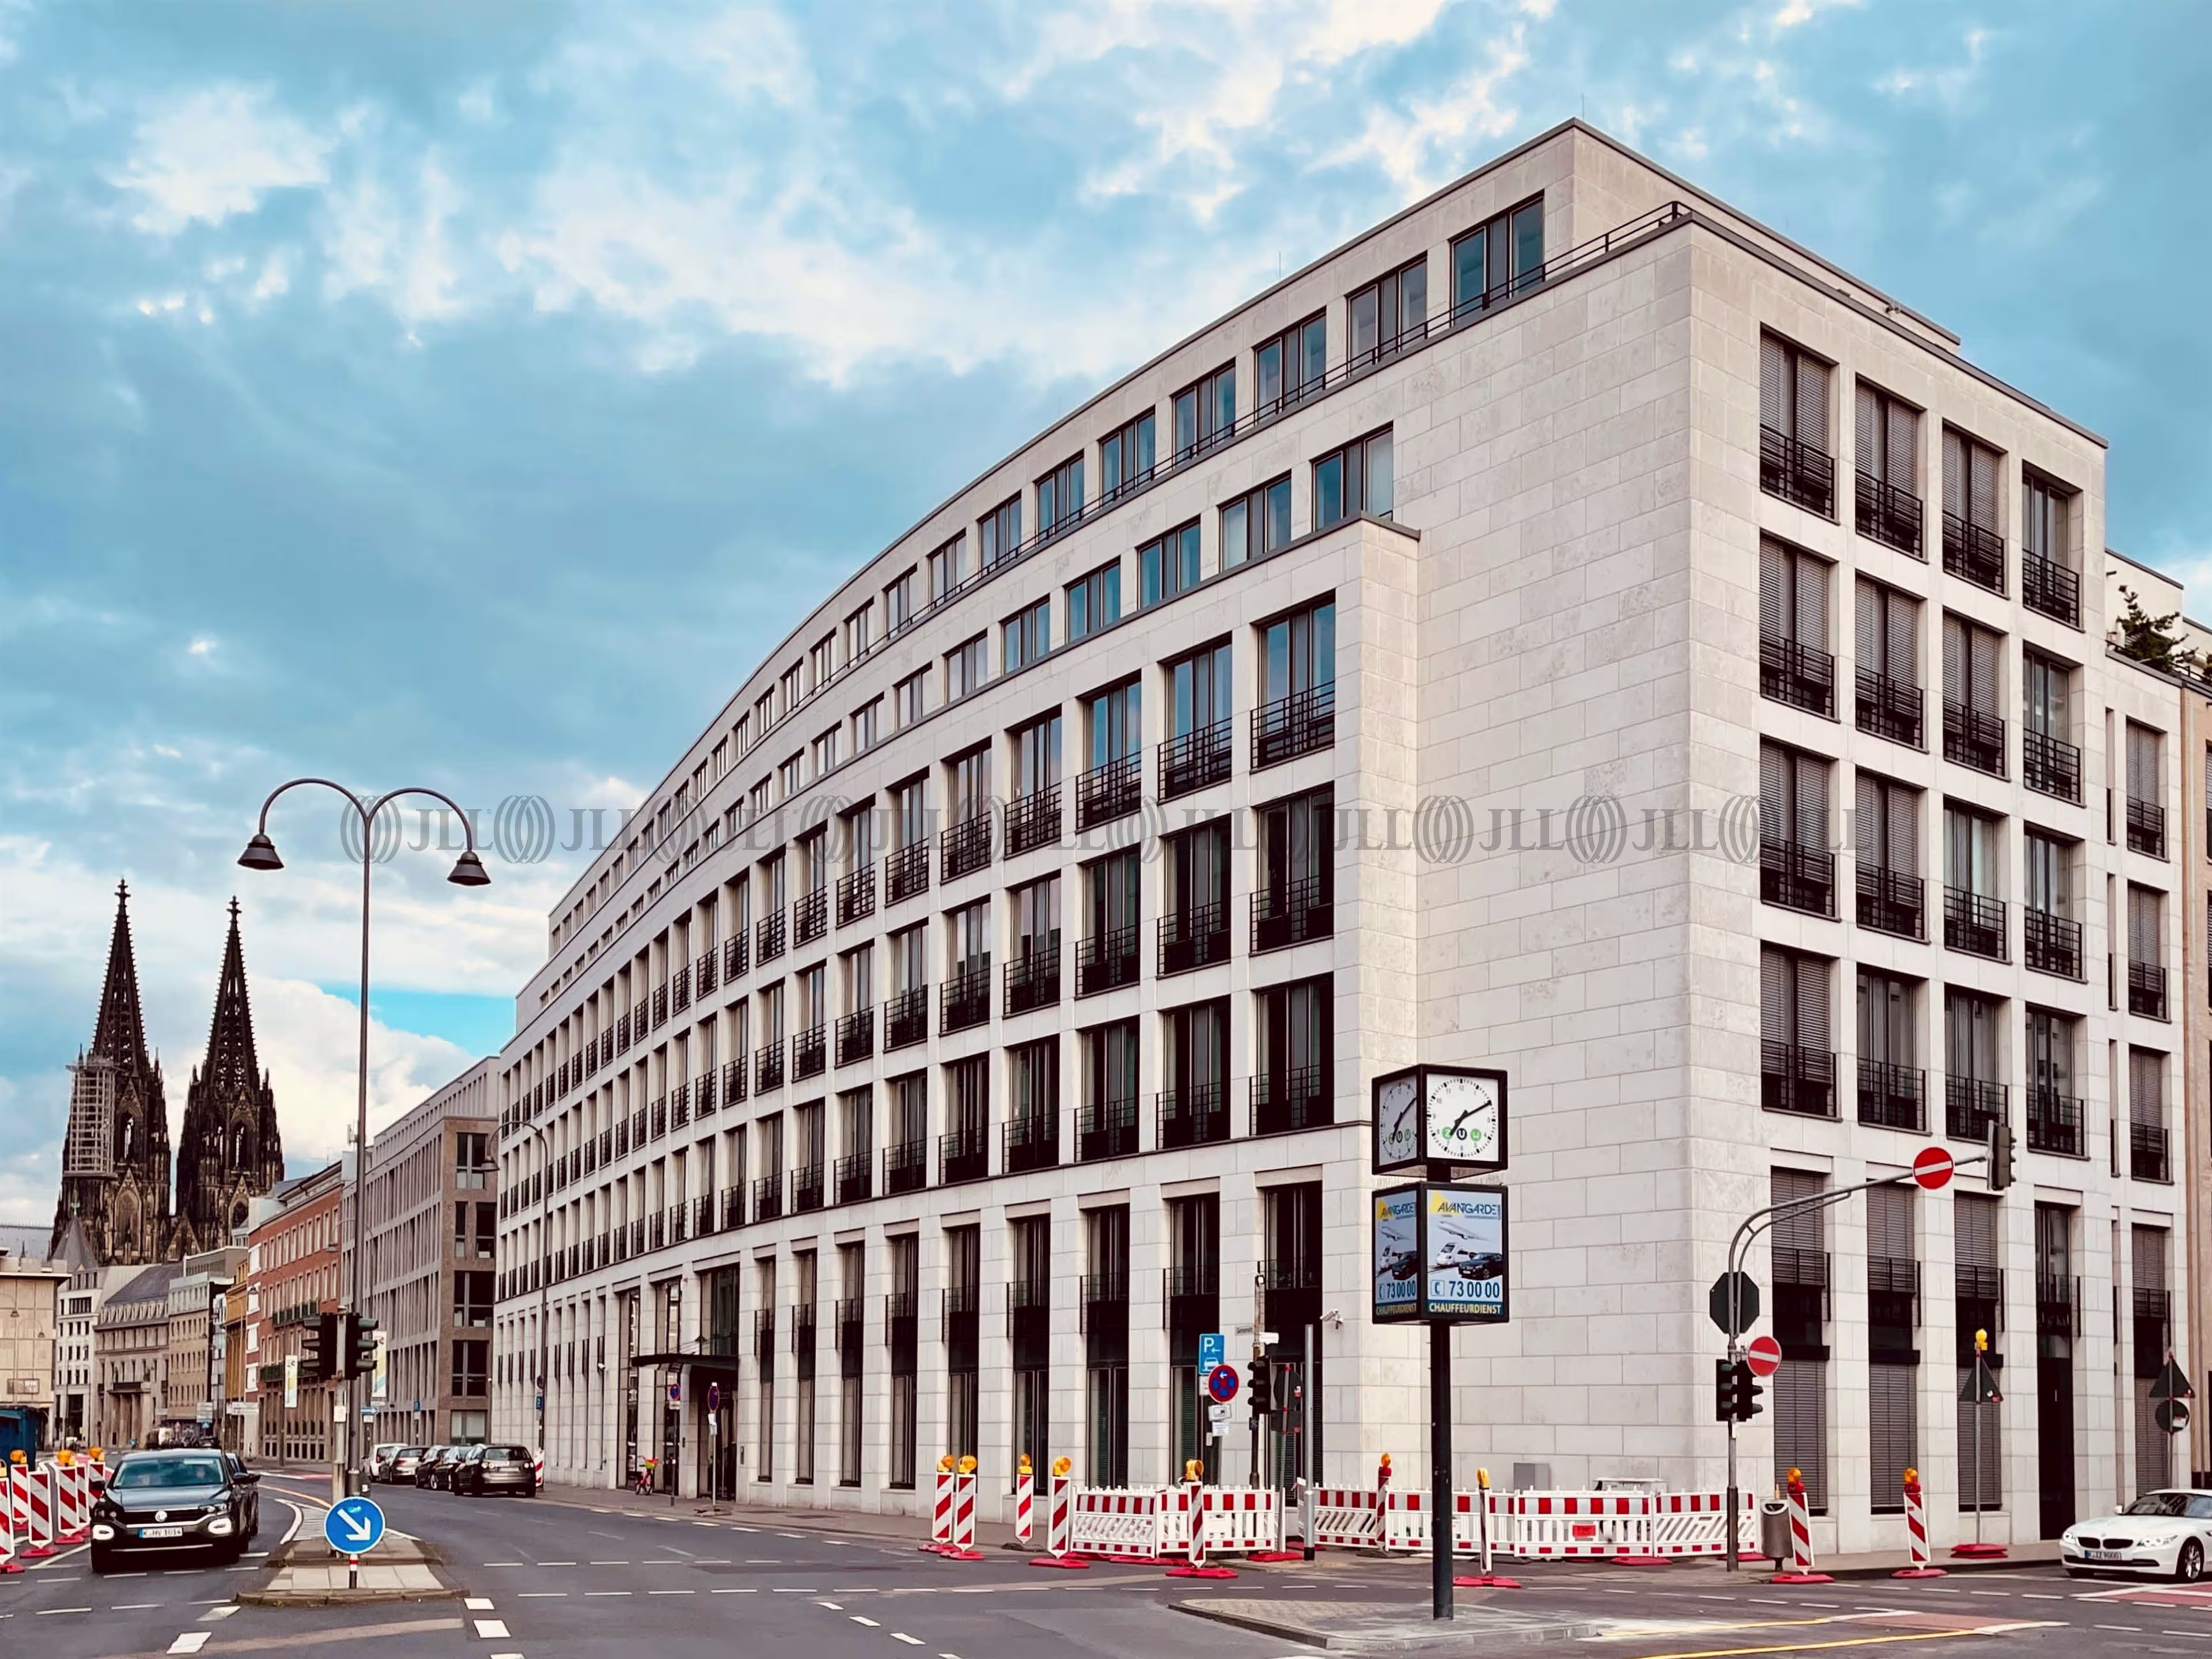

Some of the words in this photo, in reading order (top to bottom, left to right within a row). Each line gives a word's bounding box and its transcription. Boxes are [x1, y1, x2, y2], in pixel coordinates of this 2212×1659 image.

[1449, 1281, 1464, 1297] 73
[1467, 1282, 1482, 1297] 00
[1485, 1282, 1500, 1298] 00
[1429, 1302, 1501, 1315] CHAUFFEURDIENST
[1204, 1337, 1214, 1353] P
